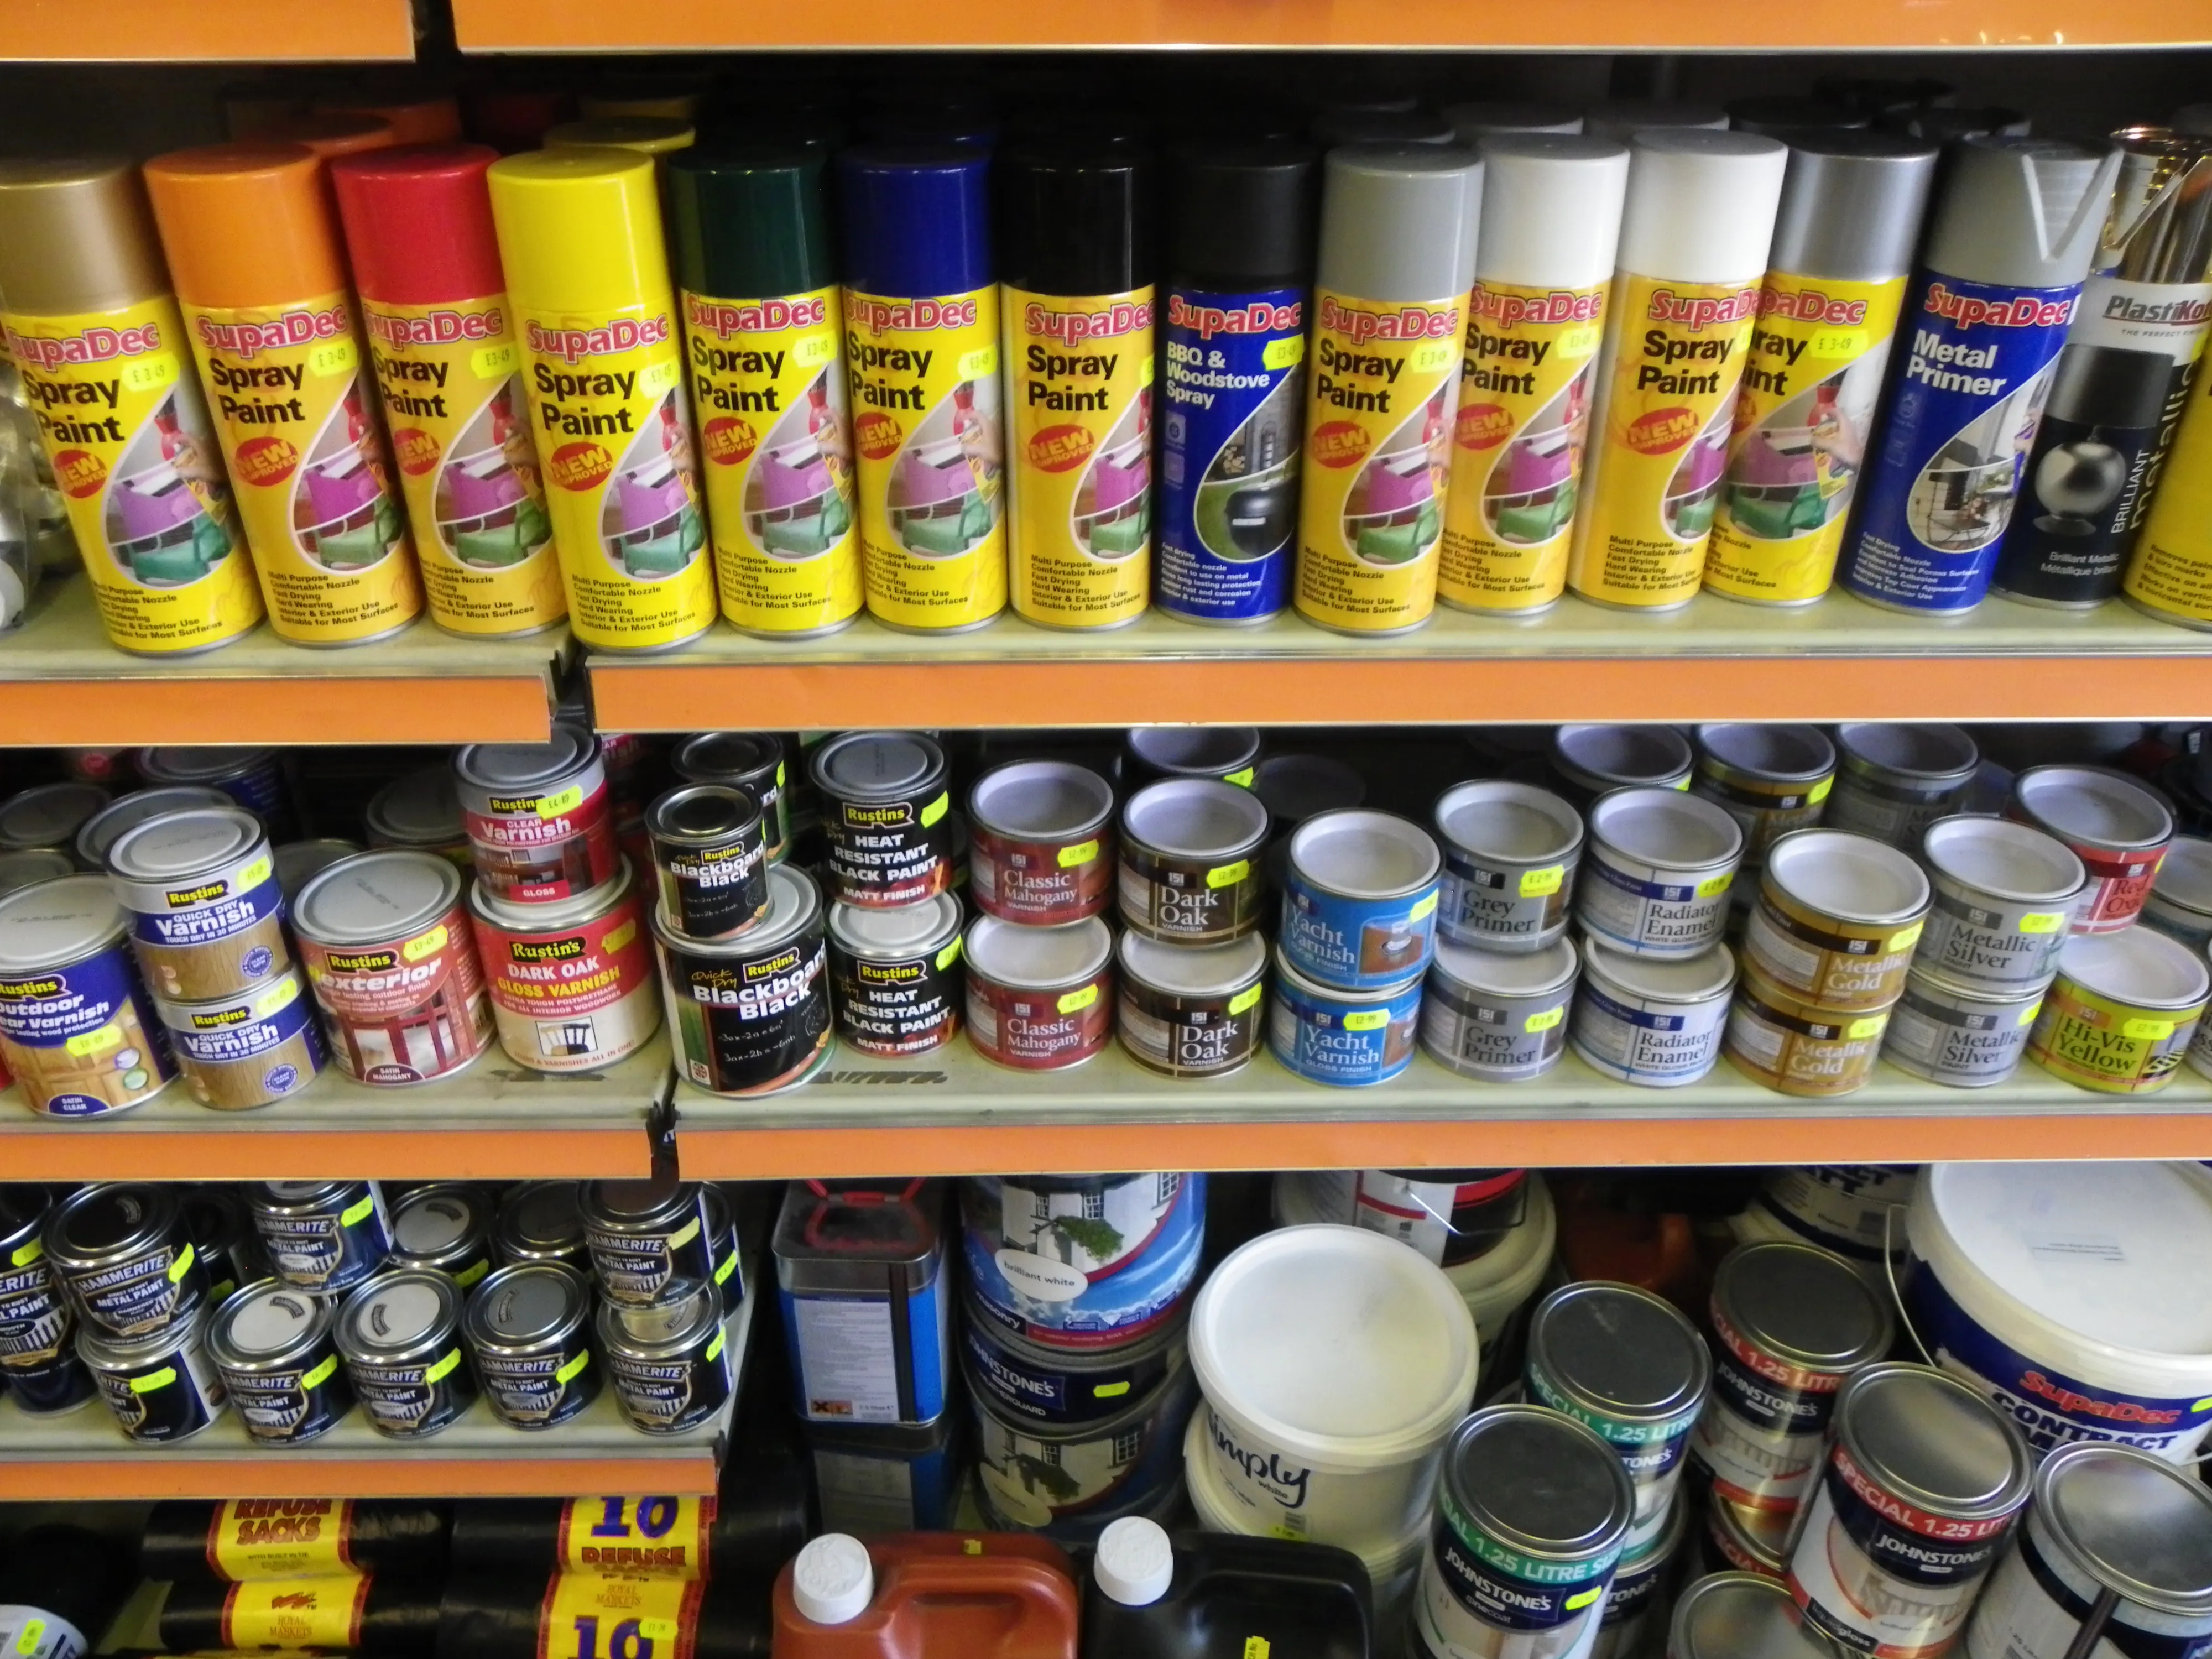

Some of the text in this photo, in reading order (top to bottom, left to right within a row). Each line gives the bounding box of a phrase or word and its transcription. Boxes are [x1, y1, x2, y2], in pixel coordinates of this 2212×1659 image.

[687, 294, 826, 340] SupaDec
[846, 290, 977, 337] SupaDec
[1168, 295, 1301, 339] SupaDec
[1470, 283, 1603, 329] SupaDec
[1925, 283, 2072, 330] SupaDec
[198, 304, 347, 359] SupaDec
[1322, 297, 1459, 345] SupaDec
[526, 313, 669, 364] SupaDec
[1465, 323, 1551, 366] Spray
[1644, 330, 1735, 364] Spray
[1913, 330, 1998, 370] Metal
[374, 346, 448, 387] Spray
[692, 335, 785, 378] Spray
[848, 332, 933, 378] Spray
[1027, 345, 1118, 380] Spray
[1167, 341, 1225, 368] BBQ &
[1319, 338, 1404, 384] Spray
[208, 358, 303, 392] Spray
[535, 362, 635, 401] Spray
[1167, 362, 1270, 390] Woodstove
[1462, 359, 1535, 395] Paint
[1637, 365, 1720, 395] Paint
[1907, 356, 2007, 396] Primer
[23, 369, 121, 409] Spray
[384, 385, 447, 418] Paint
[697, 376, 779, 412] Paint
[851, 373, 925, 411] Paint
[1029, 381, 1109, 411] Paint
[1167, 382, 1214, 409] Spray
[1317, 373, 1390, 414] Paint
[222, 394, 305, 425] Paint
[543, 402, 633, 435] Paint
[39, 410, 124, 443] Paint
[1629, 411, 1697, 444] NEW
[1029, 430, 1089, 462] NEW
[2111, 450, 2150, 534] BRILLIANT
[1031, 555, 1092, 569] Multi Purpose
[1032, 565, 1118, 576] Comfortable Nozzle
[1032, 572, 1080, 587] Fast Drying
[1032, 581, 1089, 594] Hard Wearing
[1076, 592, 1110, 602] Exterior
[1086, 602, 1107, 610] Most
[507, 819, 542, 828] CLEAR
[848, 807, 905, 823] Rustins
[481, 818, 571, 842] Varnish
[855, 834, 904, 846] HEAT
[671, 843, 764, 875] Blackboard
[704, 846, 740, 861] Rustins
[834, 843, 928, 864] RESISTANT
[699, 868, 749, 887] Black
[831, 858, 938, 881] BLACK PAINT
[1004, 870, 1071, 887] Classic
[169, 884, 223, 905] Rustins
[523, 888, 555, 896] GLOSS
[844, 885, 925, 900] MATT FINISH
[1004, 888, 1078, 905] Mahogany
[1162, 886, 1218, 906] Dark
[1464, 890, 1515, 916] Grey
[156, 901, 255, 936] Varnish
[174, 900, 238, 923] QUICK DRY
[1007, 902, 1047, 911] VARNISH
[1161, 906, 1208, 925] Oak
[228, 916, 256, 932] MINUTES
[1162, 923, 1203, 932] VARNISH
[1292, 910, 1344, 945] Yacht
[1460, 909, 1535, 932] Primer
[1646, 919, 1715, 936] Enamel
[513, 941, 581, 957] Rustin's
[1289, 929, 1355, 964] Varnish
[1952, 924, 2036, 952] Metallic
[330, 954, 390, 968] Rustins
[508, 956, 599, 980] DARK OAK
[748, 955, 794, 976] Rustins
[1833, 955, 1903, 973] Metallic
[1947, 941, 2012, 970] Silver
[498, 967, 620, 998] GLOSS VARNISH
[862, 966, 919, 980] Rustins
[1828, 973, 1881, 990] Gold
[556, 983, 618, 1005] POLYURETHANE
[740, 982, 811, 1020] Black
[869, 990, 917, 1001] HEAT
[29, 999, 109, 1028] Varnish
[195, 1009, 246, 1026] Rustins
[848, 997, 941, 1018] RESISTANT
[843, 1010, 950, 1034] BLACK PAINT
[1007, 1018, 1074, 1034] Classic
[1182, 1021, 1238, 1042] Dark
[185, 1024, 278, 1052] Varnish
[858, 1035, 938, 1051] MATT FINISH
[1007, 1033, 1081, 1051] Mahogany
[1306, 1025, 1369, 1050] Yacht
[1467, 1027, 1517, 1054] Grey
[1641, 1031, 1710, 1048] Radiator
[1949, 1028, 2021, 1047] Metallic
[2065, 1018, 2136, 1053] Hi-Vis
[1181, 1040, 1229, 1058] Oak
[1305, 1047, 1379, 1064] Varnish
[1464, 1047, 1535, 1064] Primer
[1637, 1045, 1708, 1063] Enamel
[1796, 1039, 1865, 1059] Metallic
[1944, 1044, 2002, 1064] Silver
[2058, 1033, 2137, 1071] Yellow
[1306, 1060, 1338, 1071] GLOSS
[1793, 1057, 1844, 1076] Gold
[77, 1255, 165, 1291] HAMMERITE
[624, 1260, 655, 1271] PAINT
[1004, 1260, 1075, 1287] brilliant white
[97, 1280, 164, 1307] METAL PAINT
[2019, 1370, 2182, 1424] SupaDec
[1603, 1423, 1646, 1441] 1.25
[1994, 1391, 2178, 1450] CONTRACT
[1835, 1453, 1972, 1537] SPECIAL 1.25
[237, 1517, 321, 1545] SACKS
[582, 1547, 686, 1566] REFUSE
[1476, 1540, 1587, 1580] 1.25 LITRE
[1446, 1548, 1551, 1610] JOHNSTONE'S
